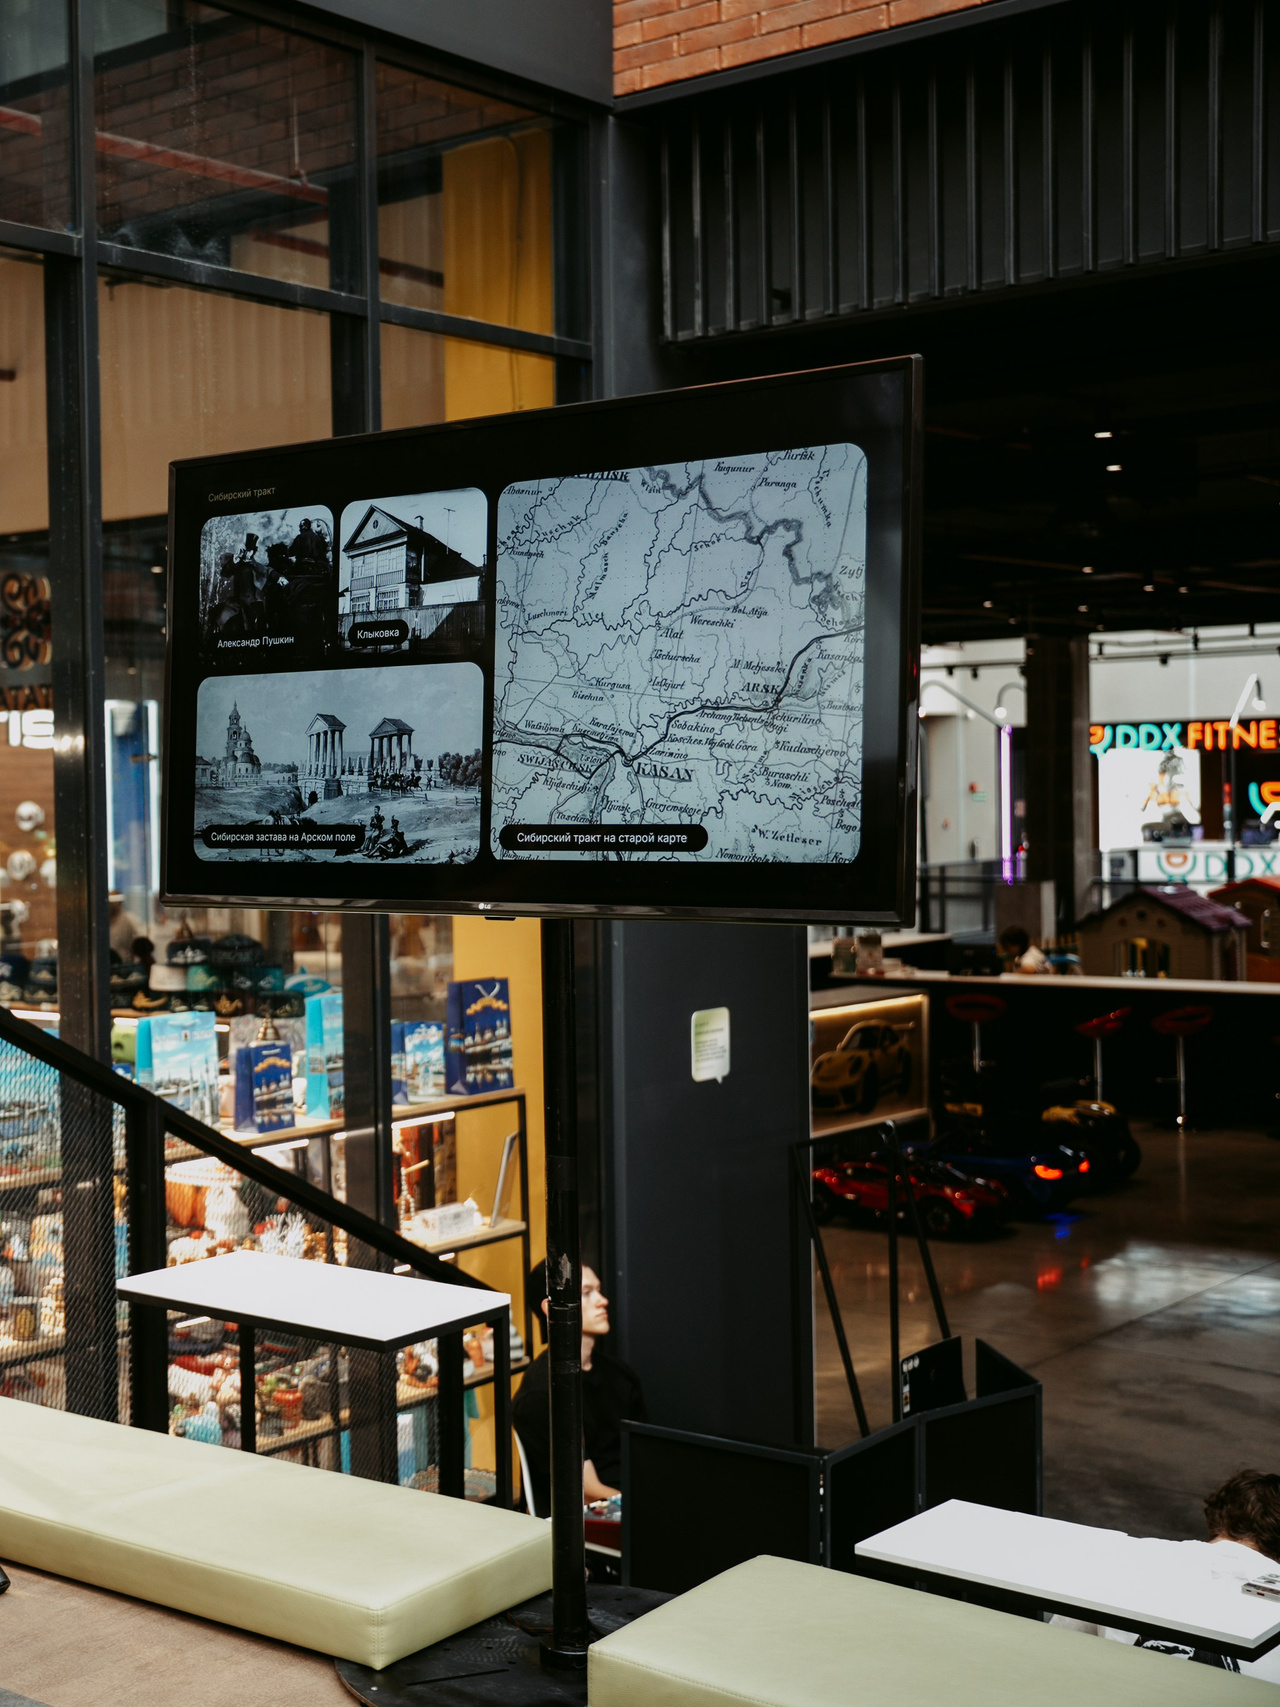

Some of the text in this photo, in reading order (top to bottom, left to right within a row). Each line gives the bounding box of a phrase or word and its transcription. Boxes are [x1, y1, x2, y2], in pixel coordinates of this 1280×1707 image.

[757, 477, 797, 492] Paranga
[208, 486, 276, 503] Сибирский тракт
[357, 628, 399, 639] Клыковка
[659, 628, 684, 640] Alat
[217, 635, 294, 649] Александр Пушкин
[741, 682, 781, 695] ARSK
[671, 719, 715, 733] Sobakino
[1115, 720, 1280, 751] DDX FITNE
[636, 761, 694, 782] KASAN
[211, 831, 356, 844] Сибирская застава на Арском поле
[517, 832, 687, 844] Сибирский тракт на старой карте
